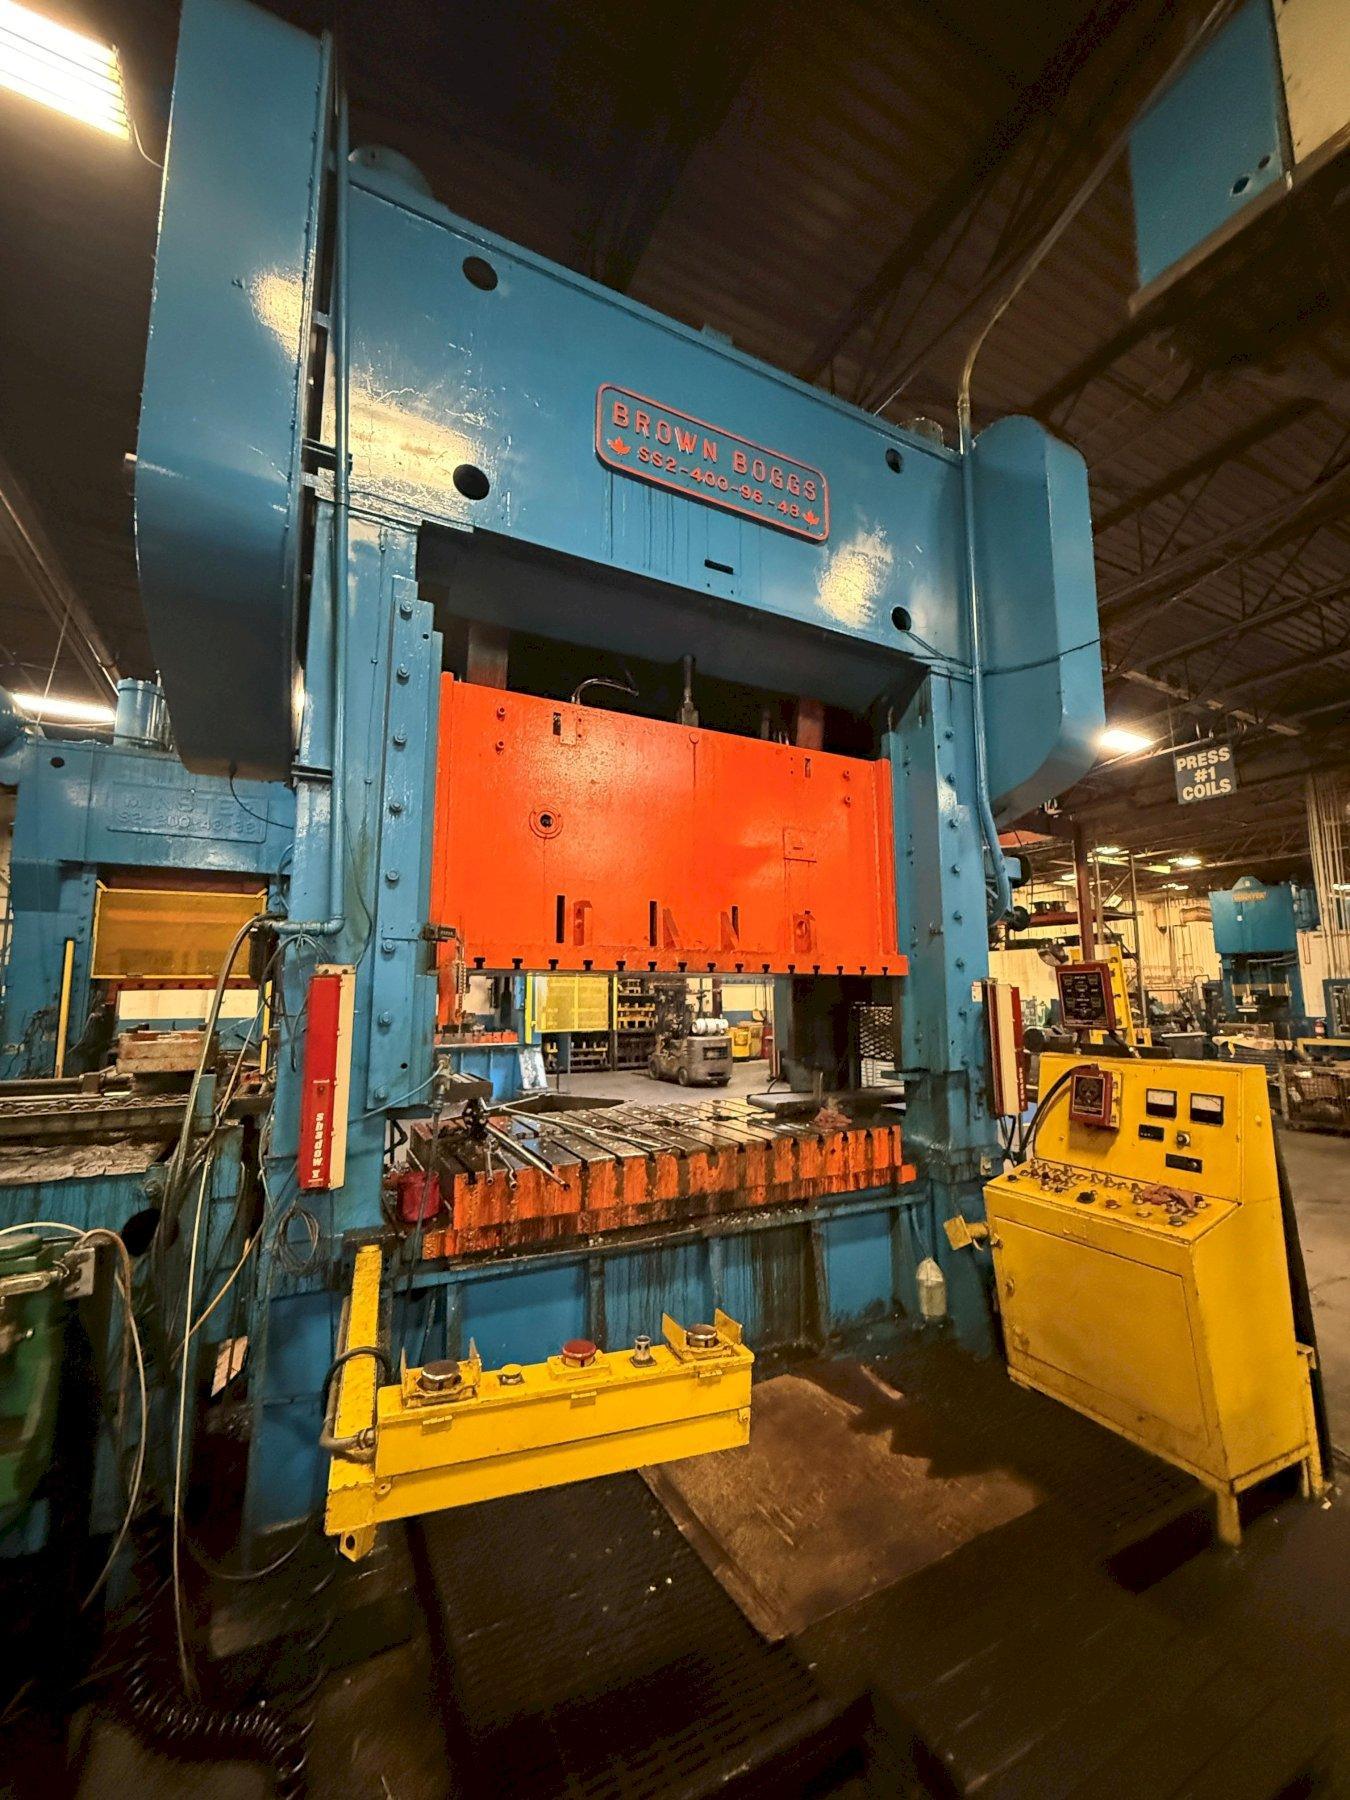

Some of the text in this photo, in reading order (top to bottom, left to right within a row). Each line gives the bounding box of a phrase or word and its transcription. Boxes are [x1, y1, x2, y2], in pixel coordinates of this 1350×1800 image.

[612, 401, 817, 502] BROWN BOGGS
[1176, 747, 1231, 772] PRESS
[1194, 766, 1216, 783] #1
[1182, 778, 1232, 801] COILS
